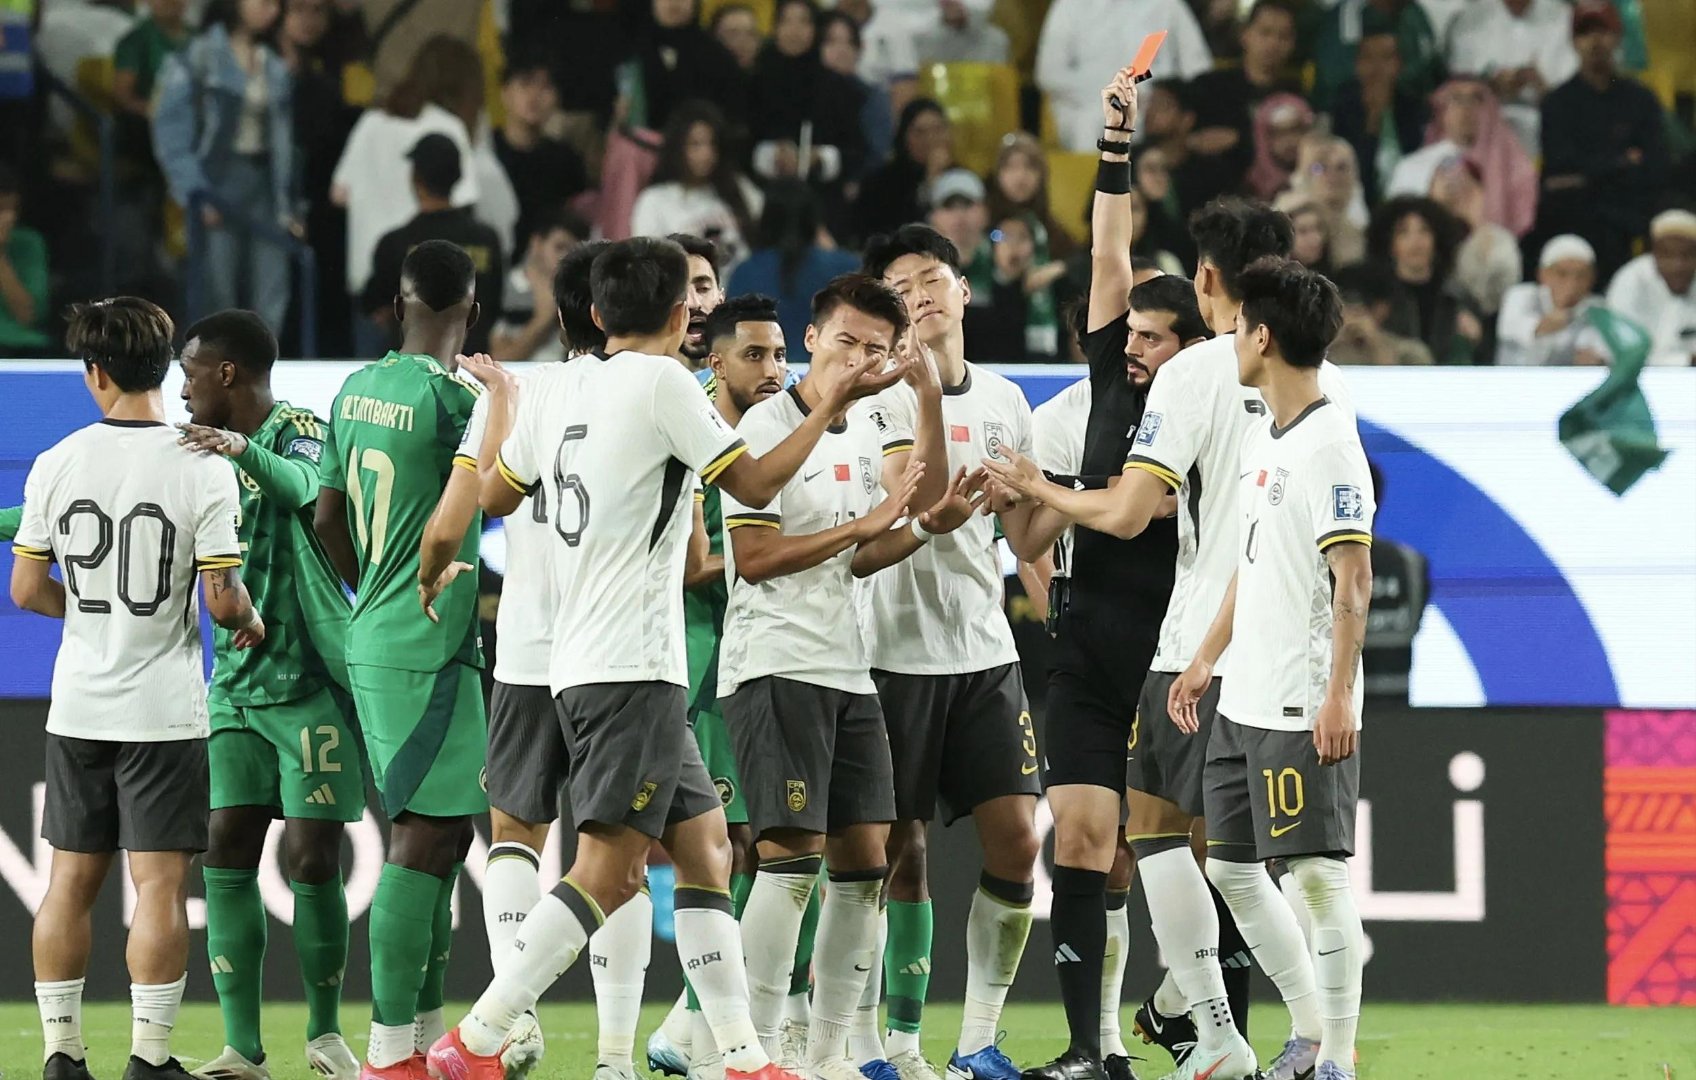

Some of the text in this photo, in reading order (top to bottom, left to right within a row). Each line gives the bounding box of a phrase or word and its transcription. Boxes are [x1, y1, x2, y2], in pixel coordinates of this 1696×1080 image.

[346, 446, 395, 566] 17
[554, 424, 590, 547] 6
[59, 499, 176, 616] 20
[301, 725, 341, 772] 12
[1019, 710, 1036, 757] 3
[1263, 767, 1304, 818] 10
[687, 951, 722, 970] 中国
